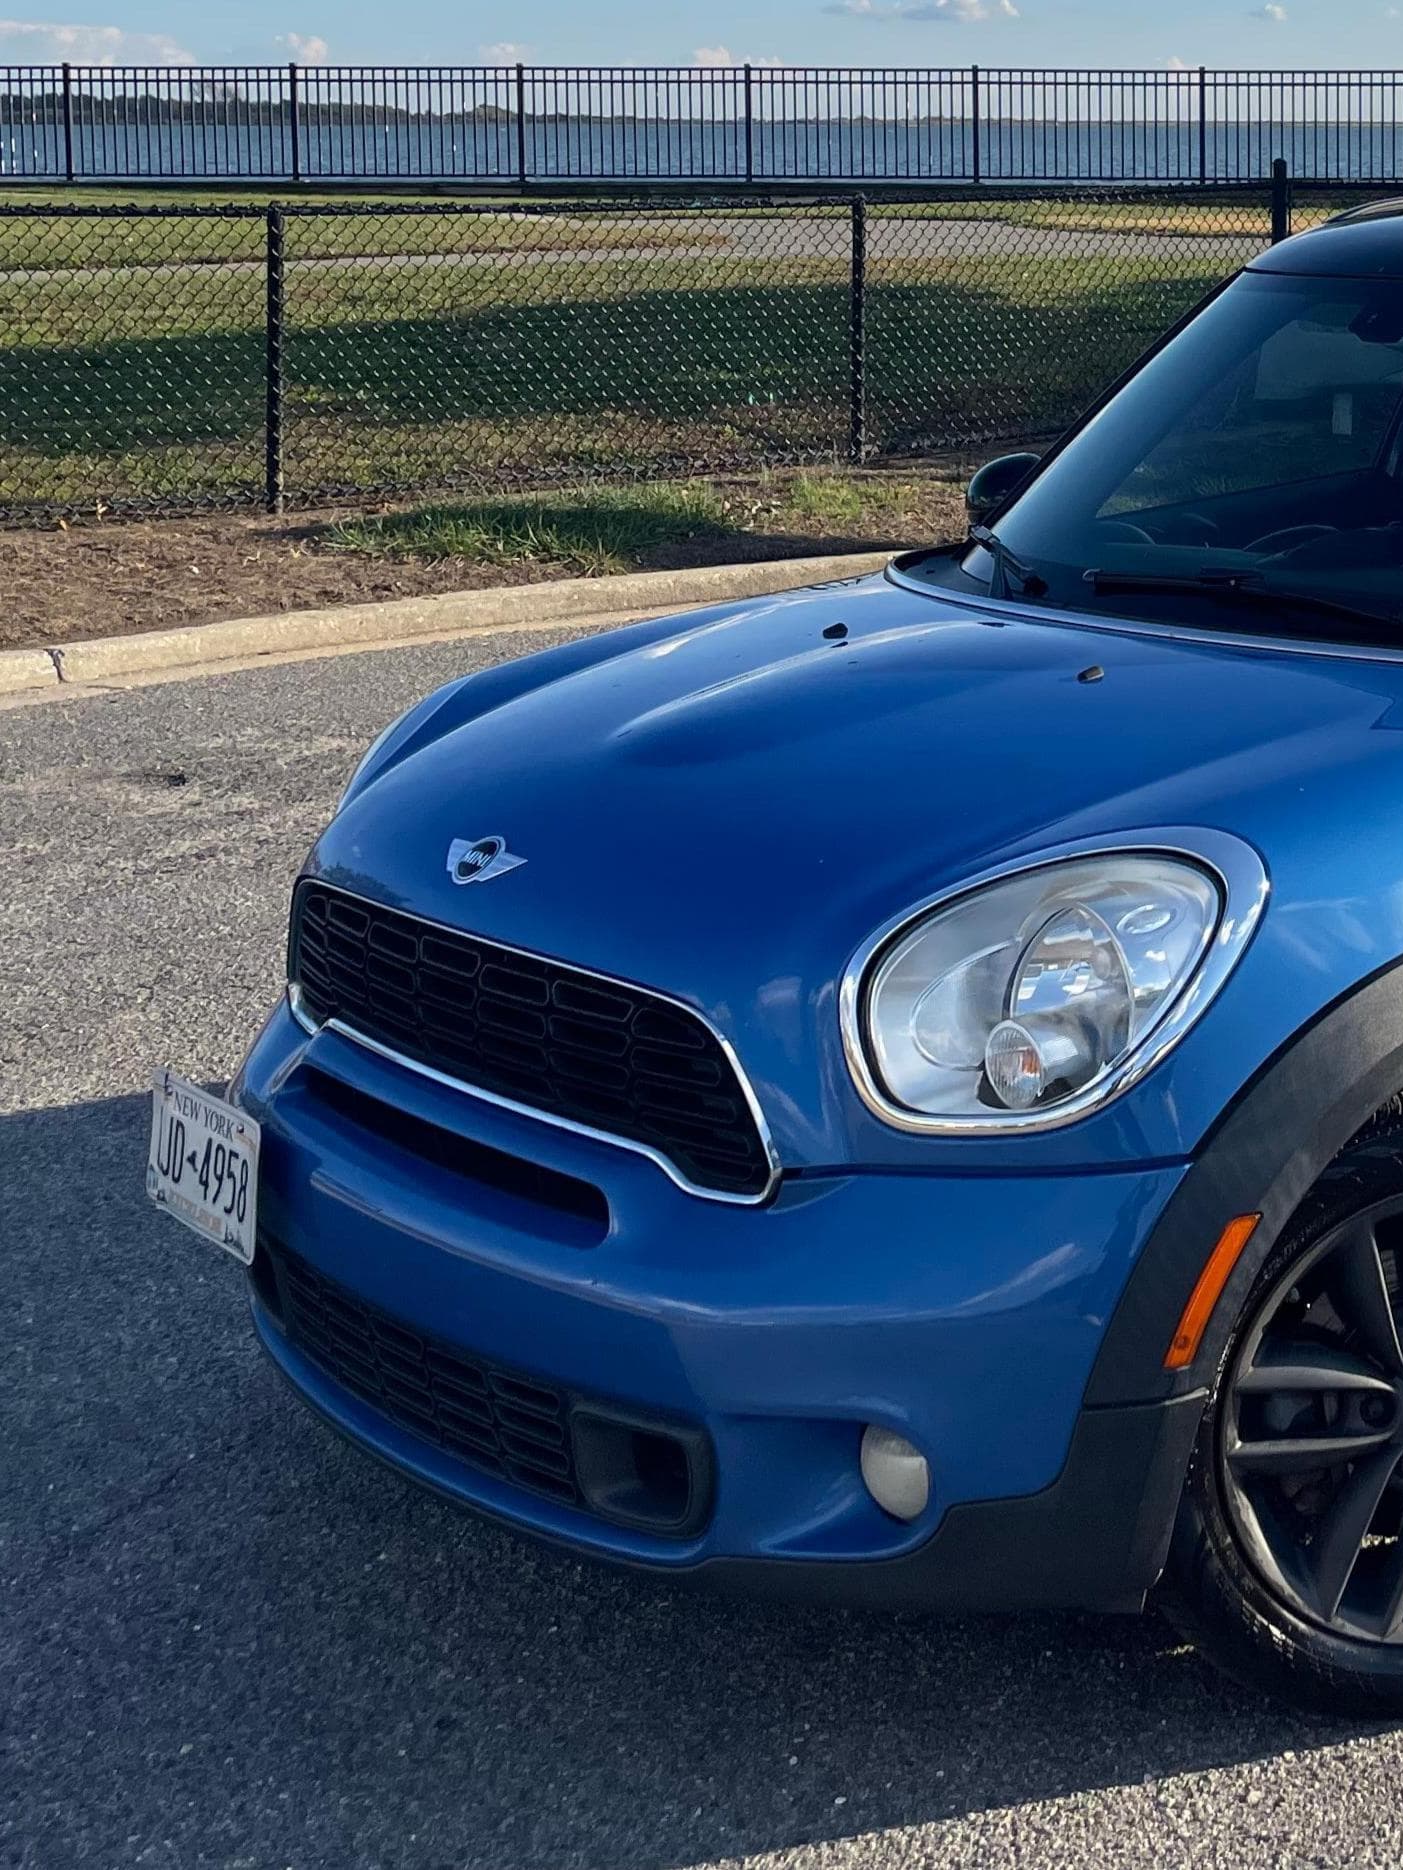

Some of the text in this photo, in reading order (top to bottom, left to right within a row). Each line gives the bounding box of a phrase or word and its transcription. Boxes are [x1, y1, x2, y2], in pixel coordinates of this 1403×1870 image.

[464, 849, 492, 867] MINI
[173, 1091, 234, 1142] NEW YORK
[199, 1136, 249, 1223] 4958
